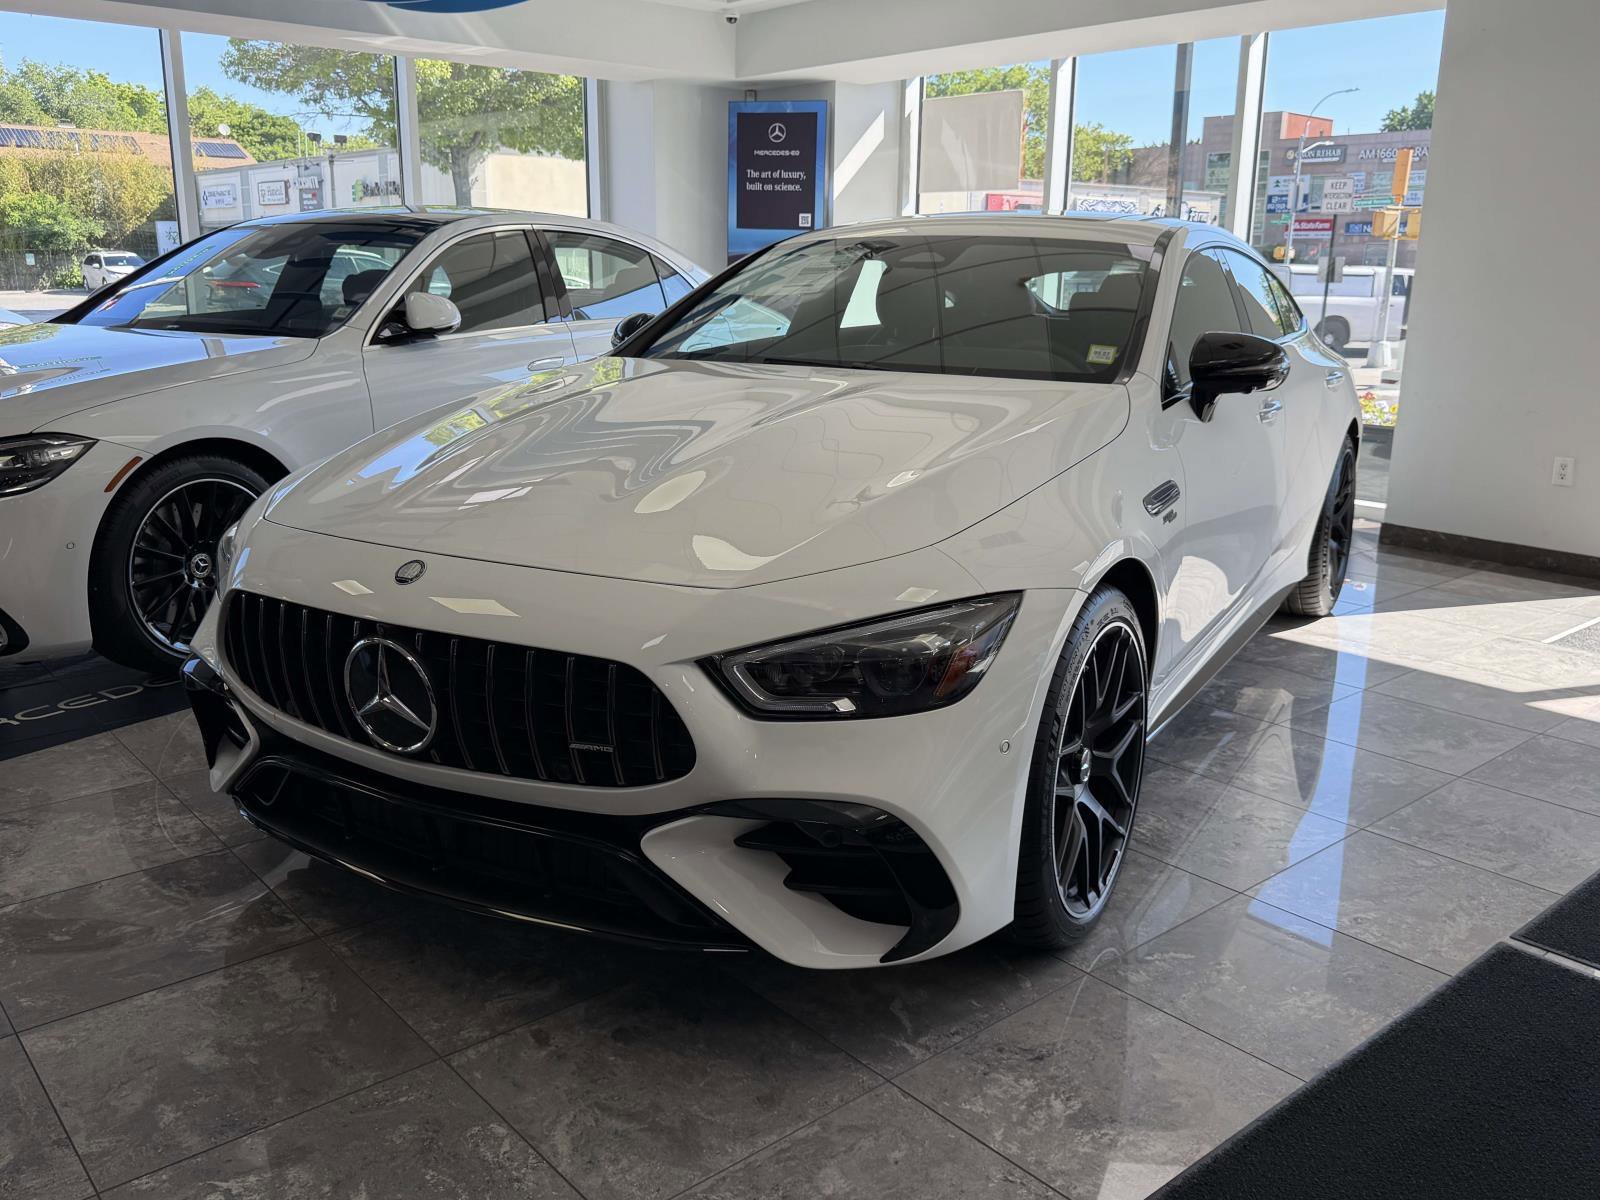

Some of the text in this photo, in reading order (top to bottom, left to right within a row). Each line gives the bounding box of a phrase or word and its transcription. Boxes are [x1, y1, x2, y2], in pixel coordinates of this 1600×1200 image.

[746, 169, 806, 180] The art of luxury,
[746, 182, 762, 191] built
[774, 182, 802, 191] science.
[1331, 182, 1347, 190] KEEP
[1326, 201, 1347, 210] CLEAR
